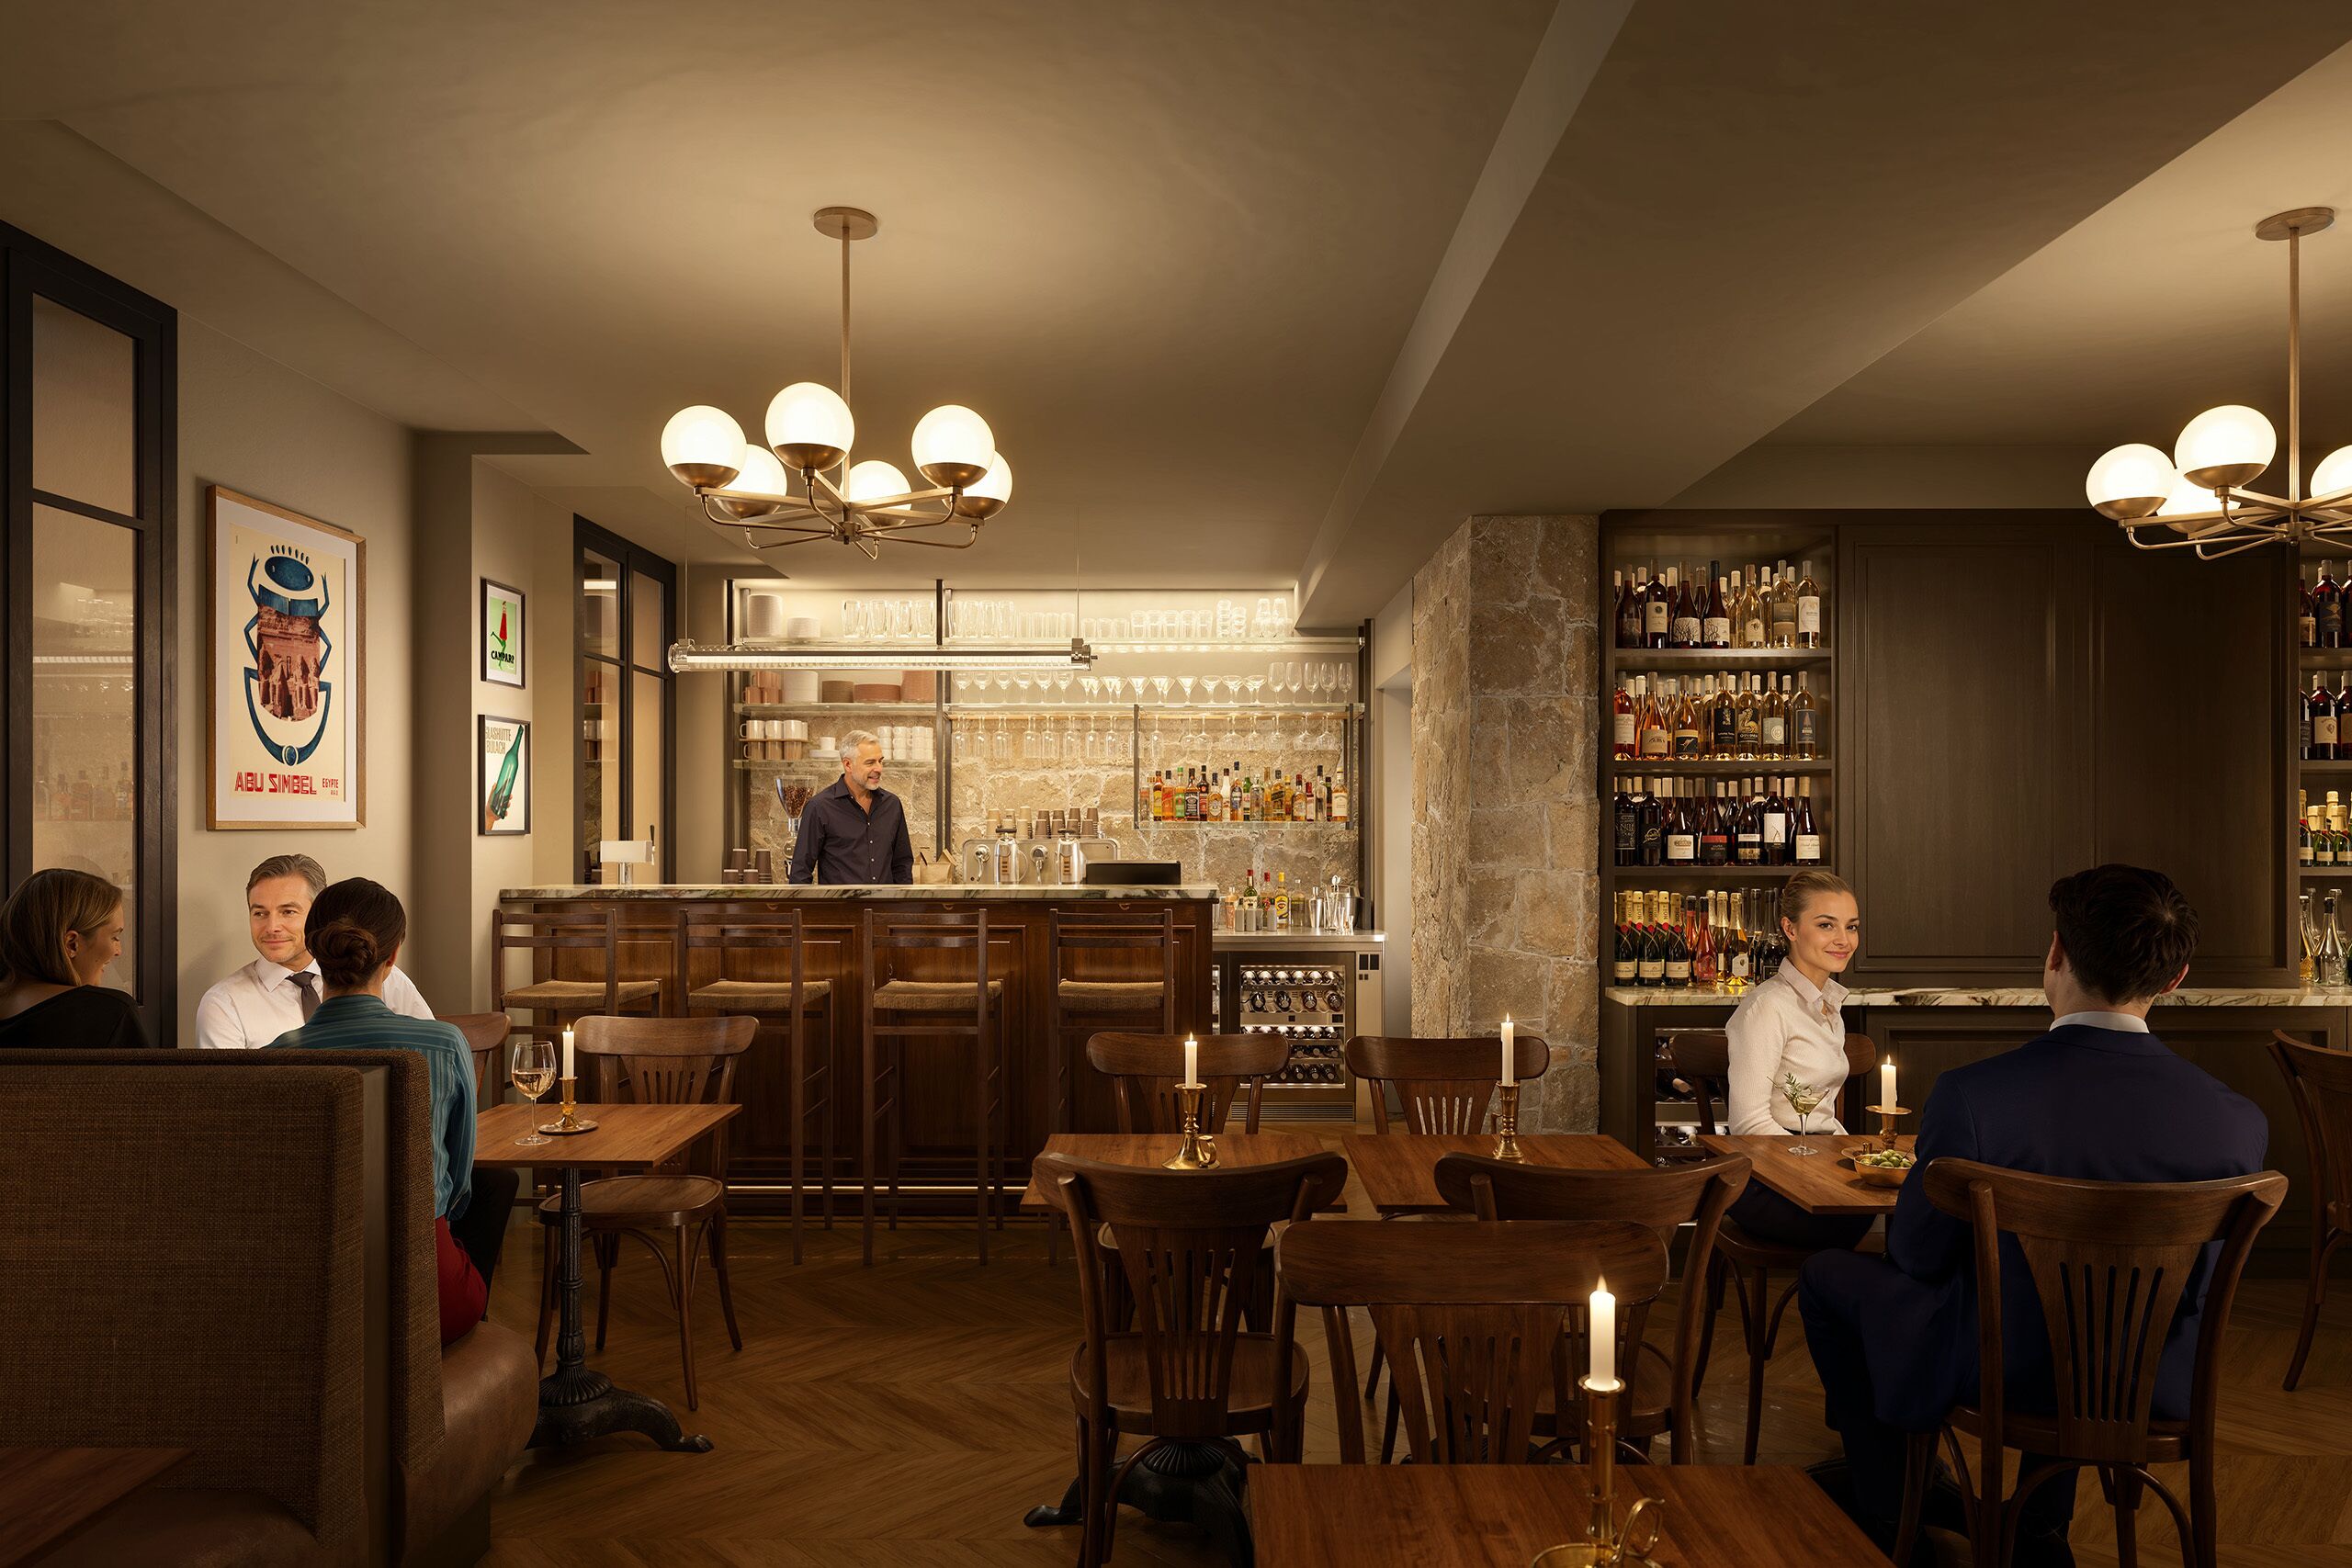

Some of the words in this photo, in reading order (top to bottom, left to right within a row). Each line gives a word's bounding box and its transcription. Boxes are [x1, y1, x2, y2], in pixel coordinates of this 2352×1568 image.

[234, 771, 264, 792] ABU
[268, 773, 317, 795] SIMBEL
[322, 778, 339, 789] EGYPTE
